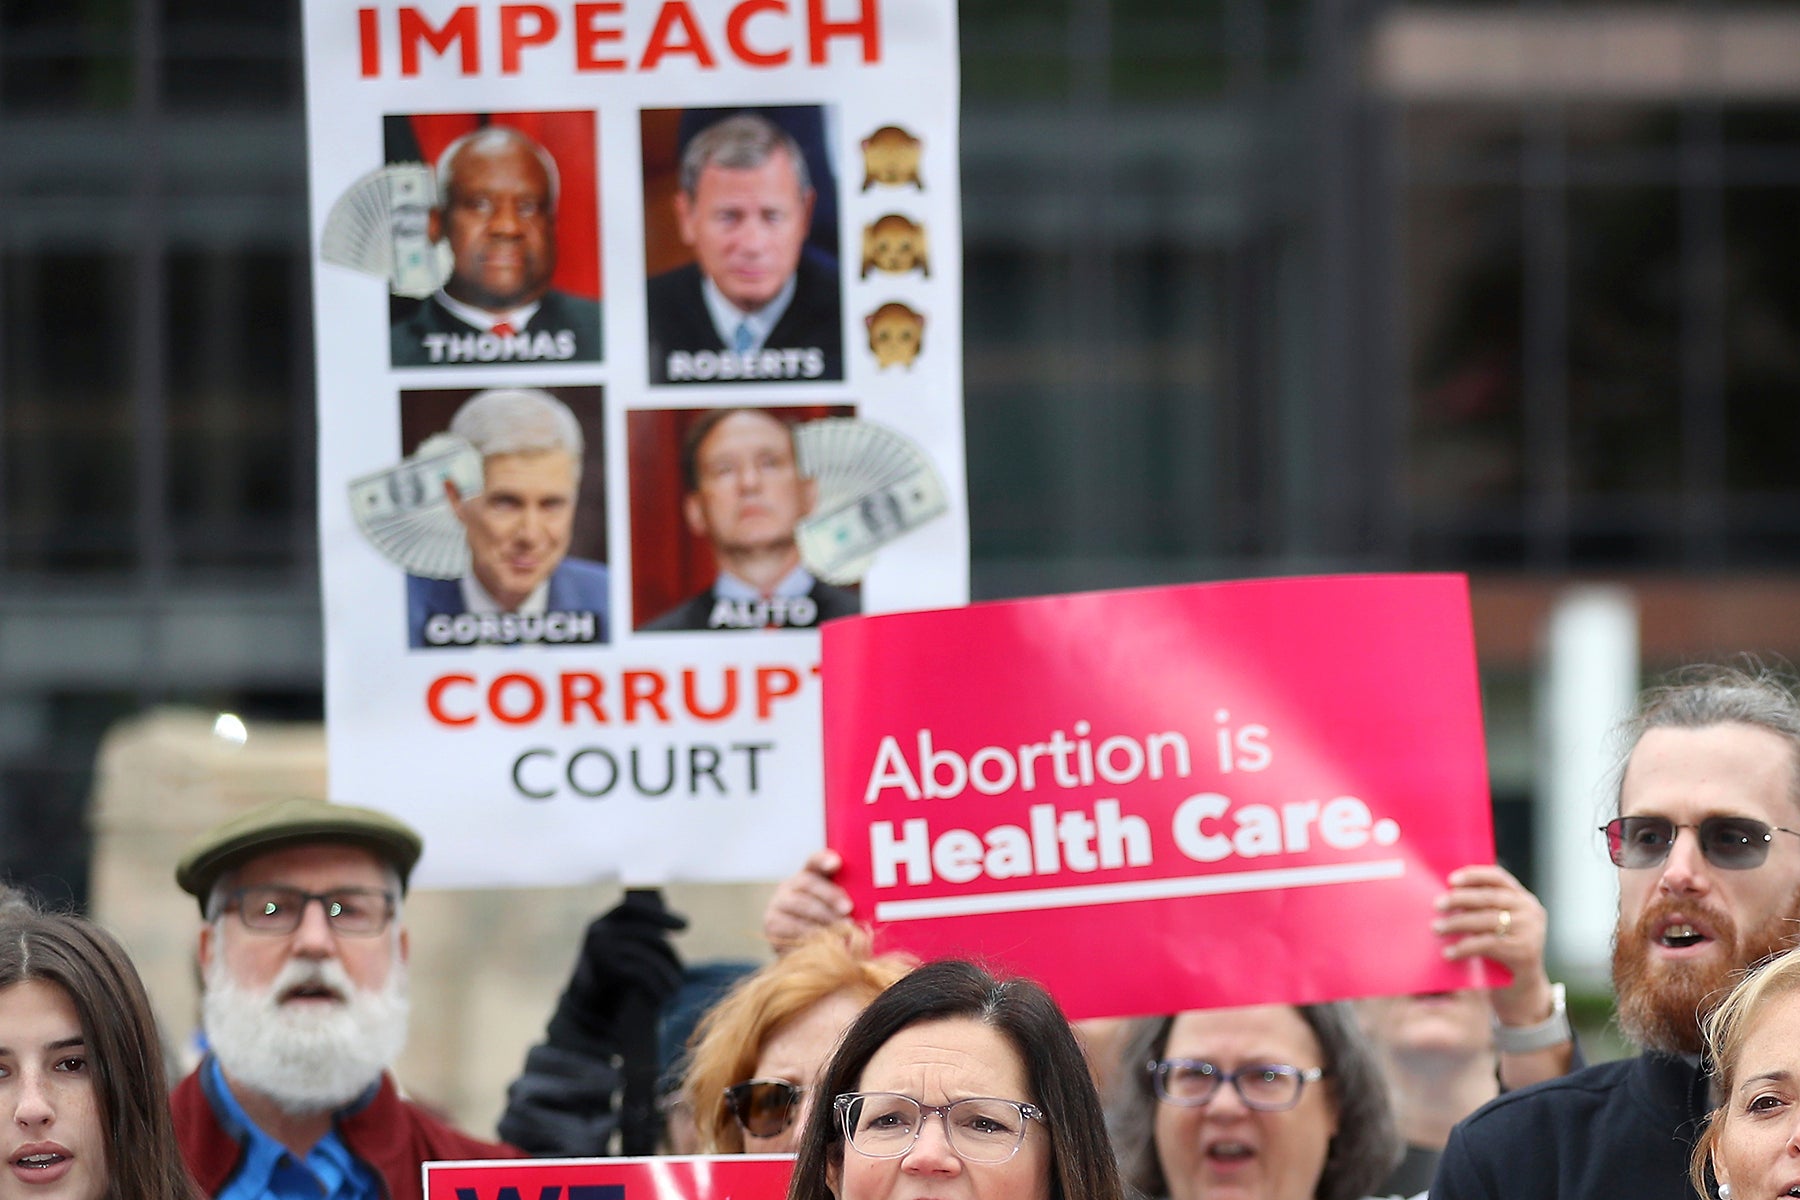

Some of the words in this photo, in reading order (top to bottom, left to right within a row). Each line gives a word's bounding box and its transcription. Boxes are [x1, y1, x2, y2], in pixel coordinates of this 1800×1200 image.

[357, 0, 882, 78] IMPEACH
[423, 331, 577, 363] THOMAS
[667, 347, 825, 380] ROBERTS
[426, 612, 597, 645] GORSUCH
[709, 597, 818, 628] ALITO
[426, 664, 822, 729] CORRUP
[512, 743, 775, 799] COURT
[866, 720, 1191, 804] Abortion
[1216, 709, 1273, 773] is
[870, 798, 1154, 888] Health
[1170, 792, 1401, 864] Care.
